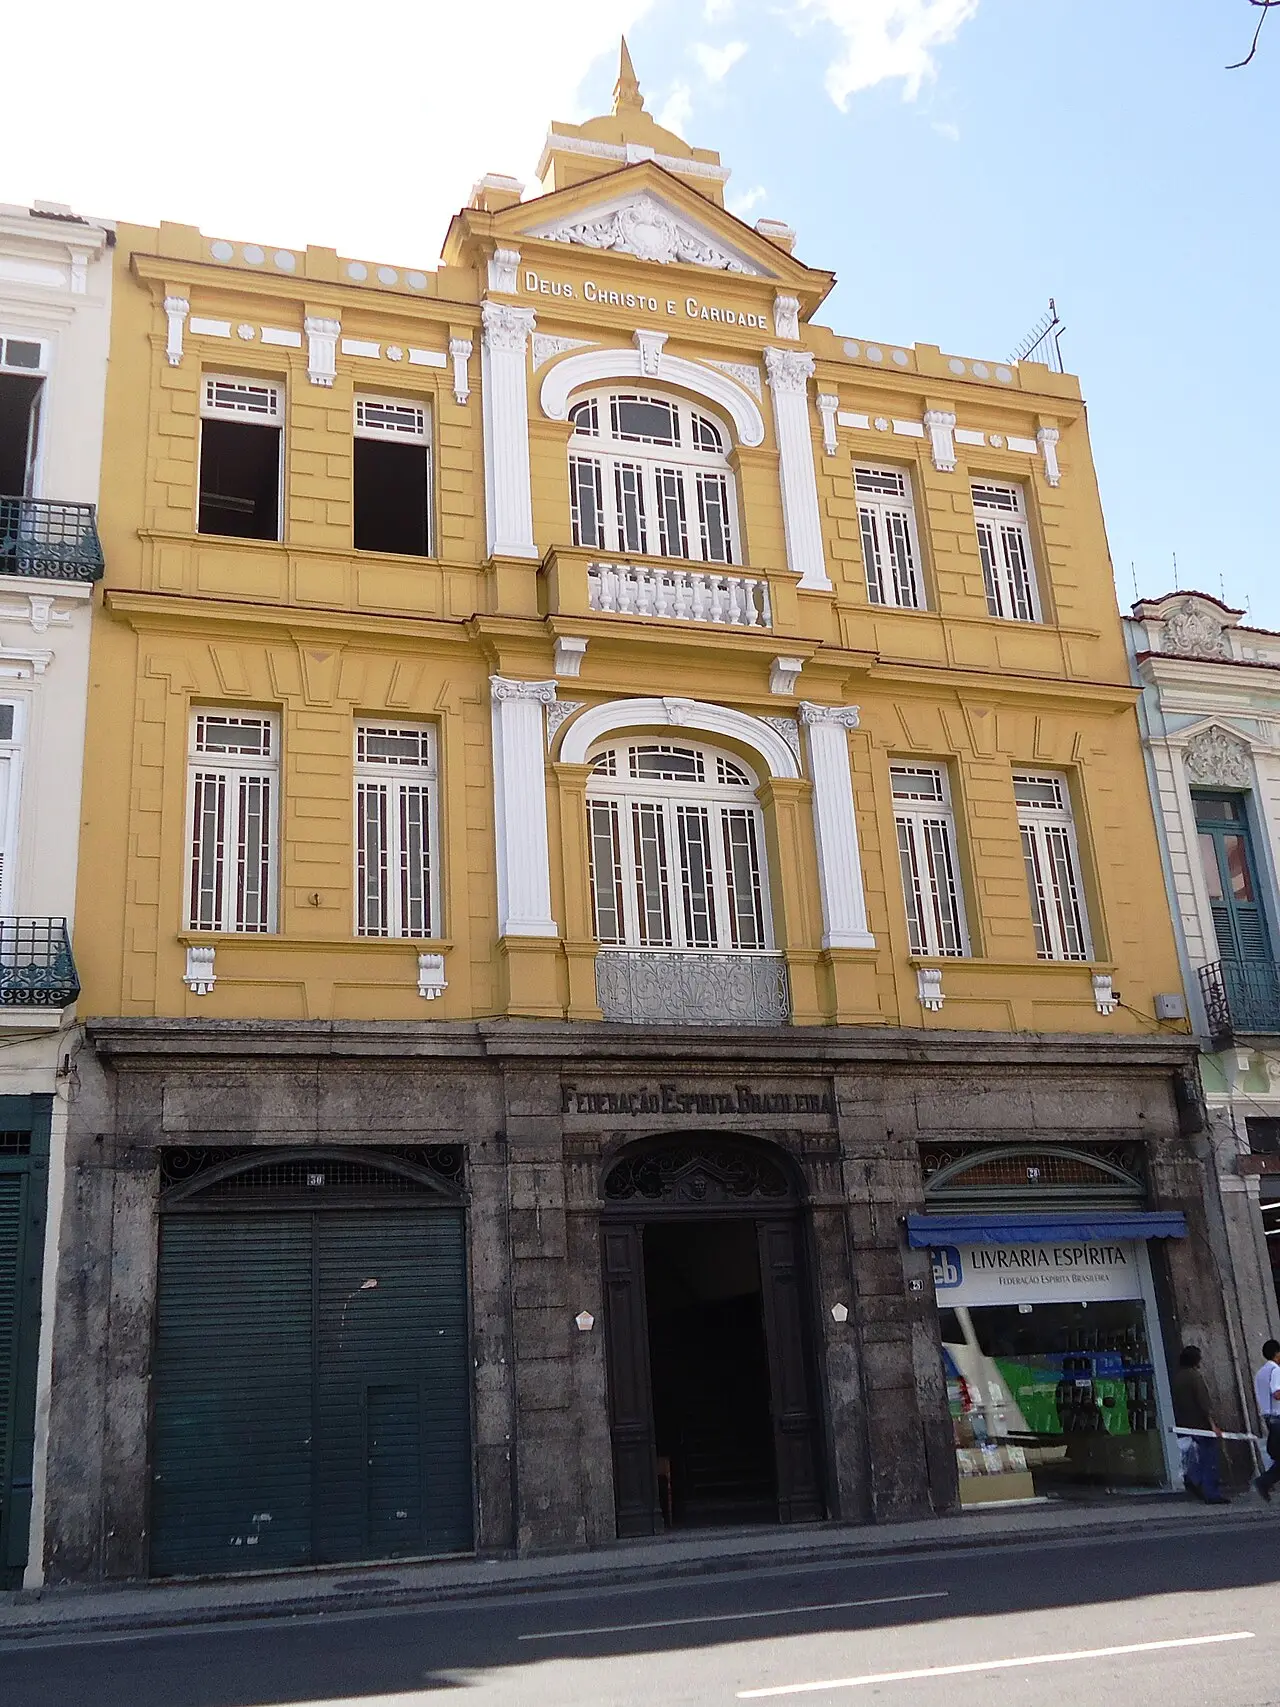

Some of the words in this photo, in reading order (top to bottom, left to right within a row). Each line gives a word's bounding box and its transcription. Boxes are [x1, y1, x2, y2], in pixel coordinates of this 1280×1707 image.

[583, 281, 658, 312] CHRISTO
[667, 298, 677, 316] E
[686, 297, 768, 330] CARIDADE
[931, 1250, 958, 1284] eb
[971, 1249, 1050, 1270] LIVRARIA
[1054, 1243, 1127, 1267] ESPÍRITA
